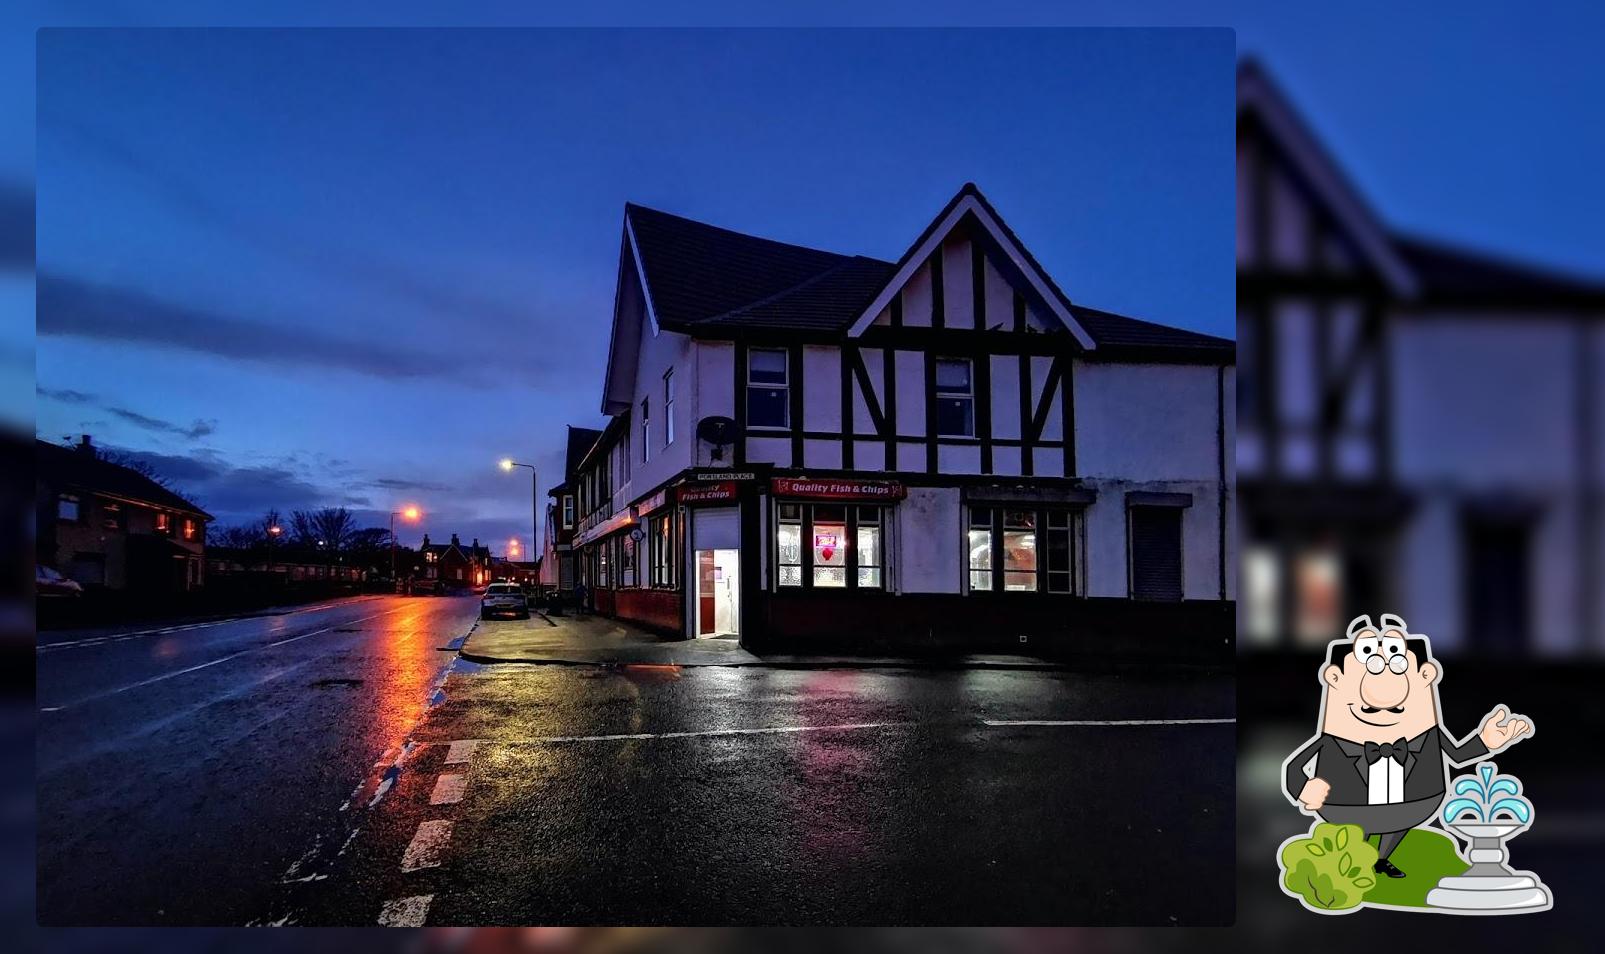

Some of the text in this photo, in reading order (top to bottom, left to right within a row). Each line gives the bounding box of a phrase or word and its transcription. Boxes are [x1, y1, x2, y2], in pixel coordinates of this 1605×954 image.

[792, 483, 889, 495] Quality Fish & Chips
[682, 493, 699, 501] Fish
[706, 491, 730, 499] Chips
